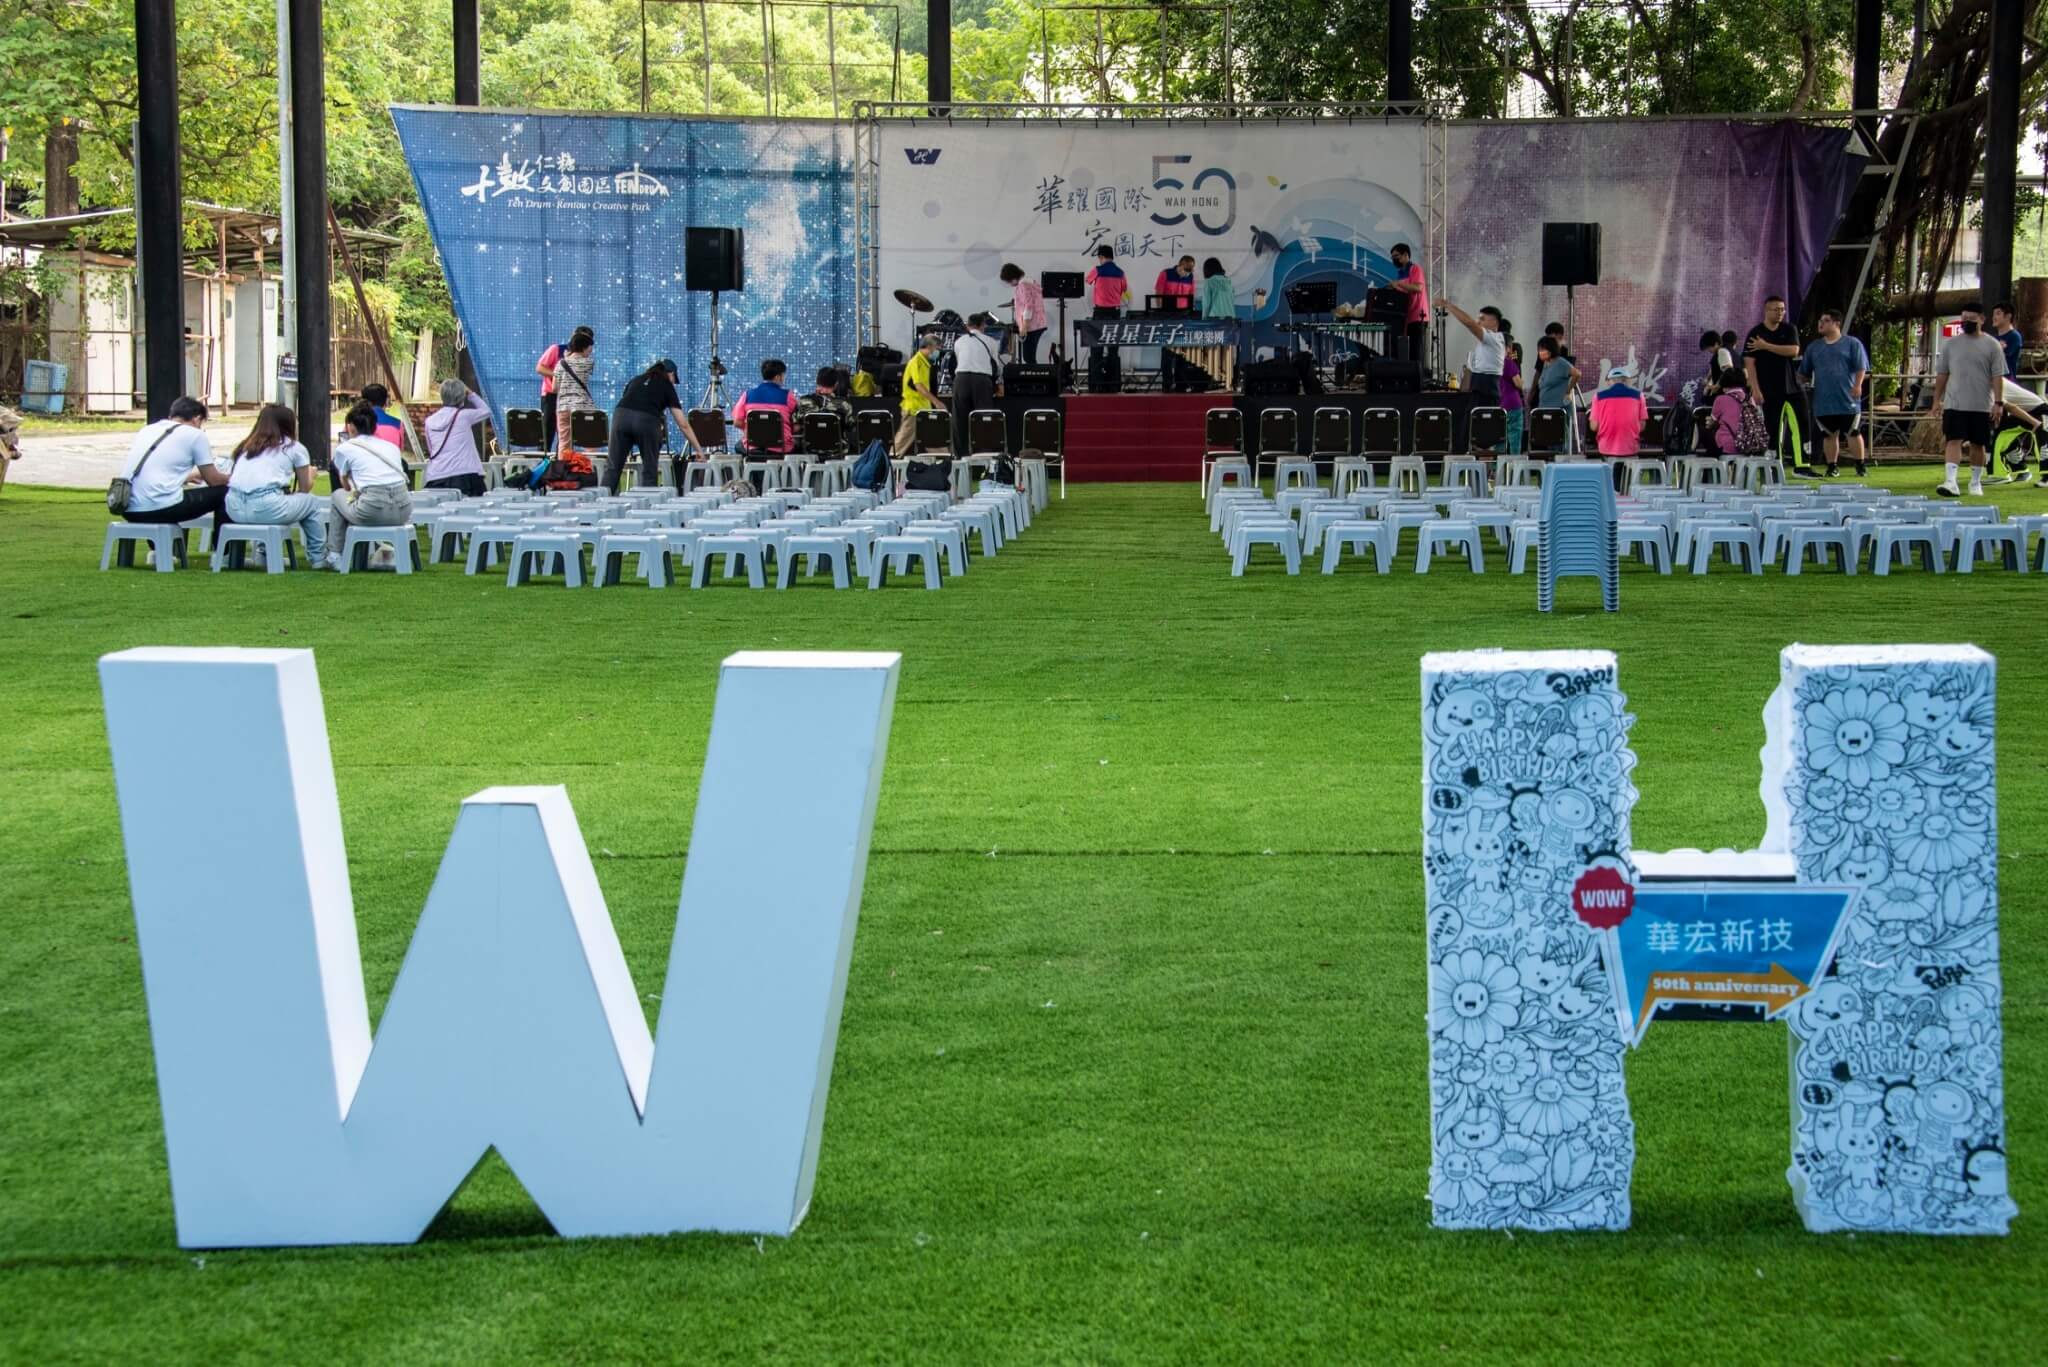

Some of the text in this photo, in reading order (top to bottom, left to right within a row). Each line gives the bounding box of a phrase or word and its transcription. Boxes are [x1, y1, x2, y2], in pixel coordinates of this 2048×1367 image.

[592, 202, 629, 211] Creative
[631, 203, 651, 212] Park
[1150, 155, 1236, 236] 50
[1164, 197, 1220, 208] WAH HONG
[1458, 727, 1544, 756] HAPPY
[1476, 753, 1588, 782] BIRTHDAY
[1580, 889, 1627, 908] WOW!
[1646, 918, 1793, 954] 華宏新技
[1653, 976, 1799, 996] 50th anniversary
[1825, 1021, 1914, 1053] HAPPY
[1847, 1048, 1962, 1075] BIRTHDAY
